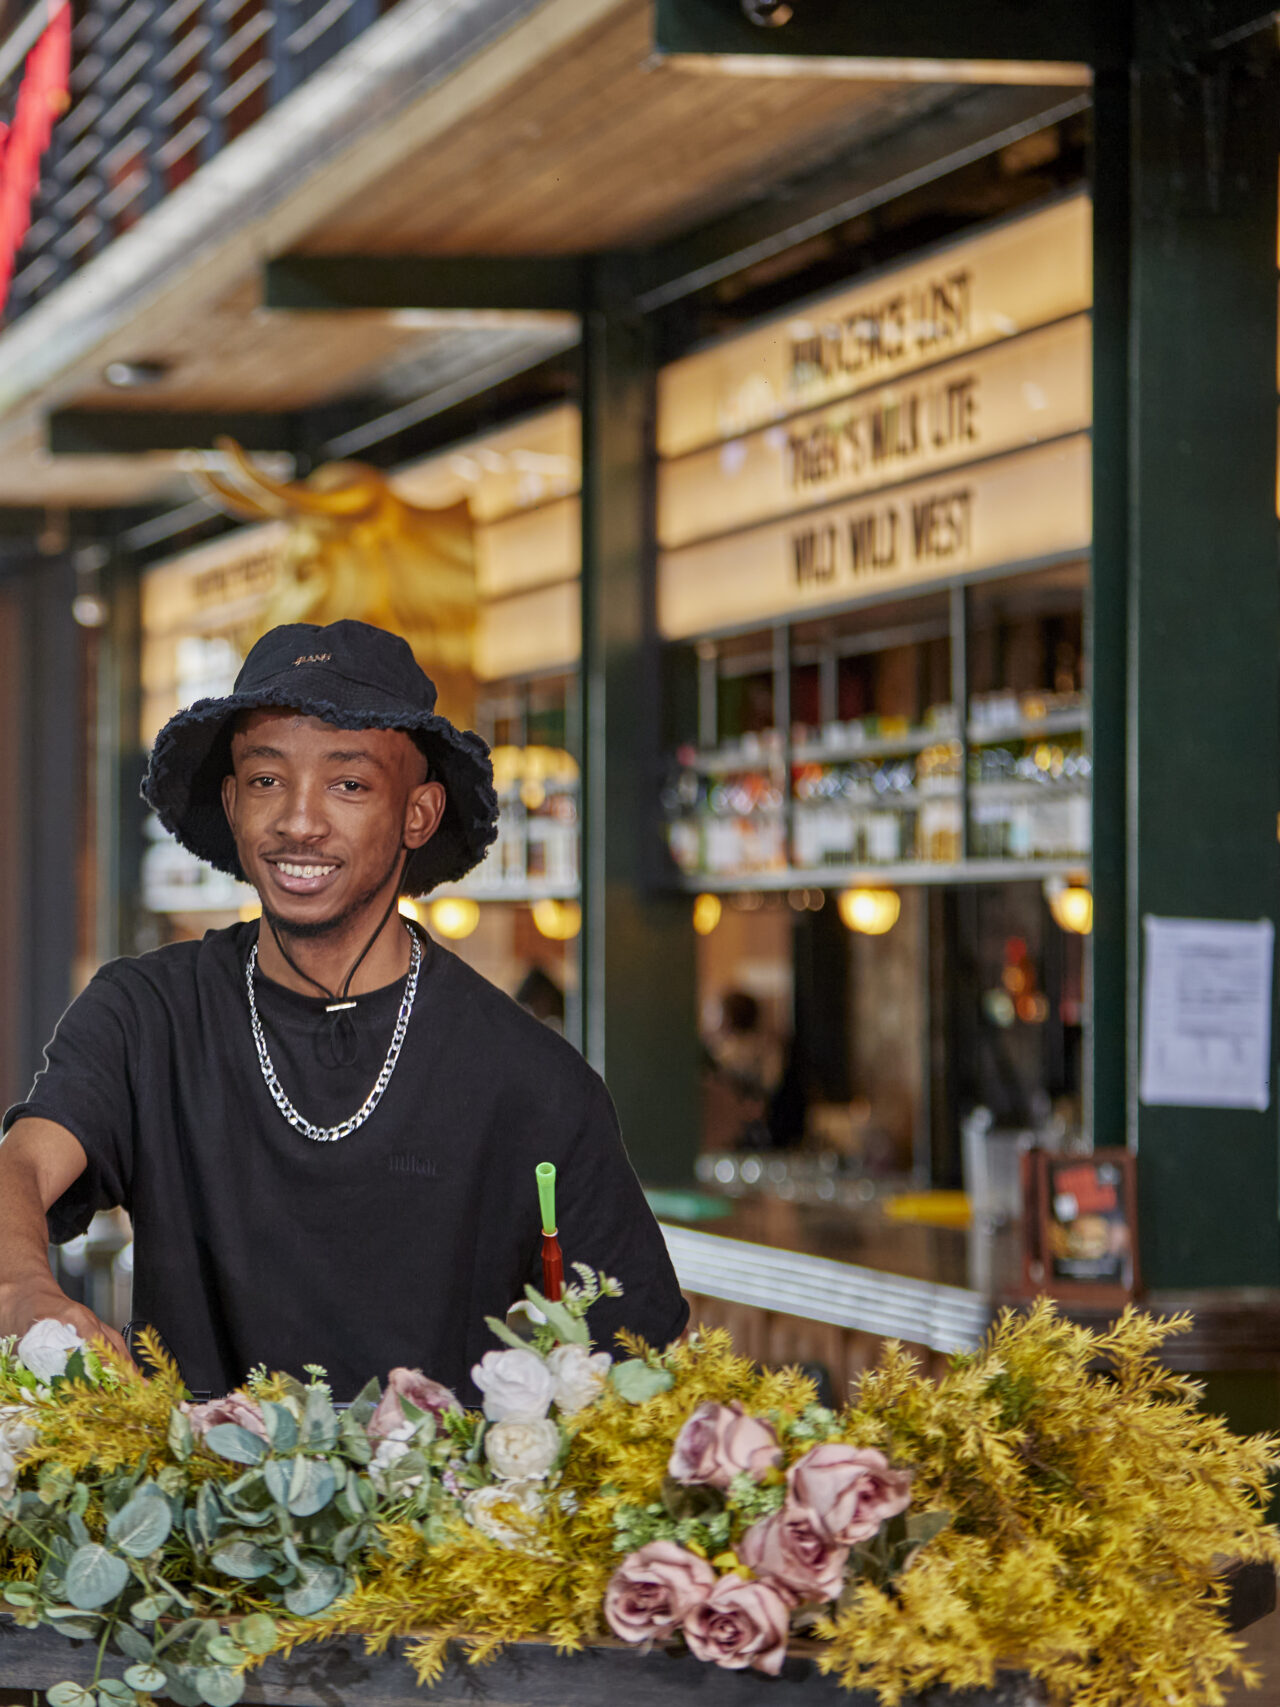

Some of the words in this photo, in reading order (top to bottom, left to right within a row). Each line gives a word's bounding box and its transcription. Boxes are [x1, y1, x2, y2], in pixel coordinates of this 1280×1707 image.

[927, 377, 977, 447] LITE
[793, 526, 837, 586] WILD
[850, 507, 897, 574] WILD
[912, 487, 970, 559] WEST
